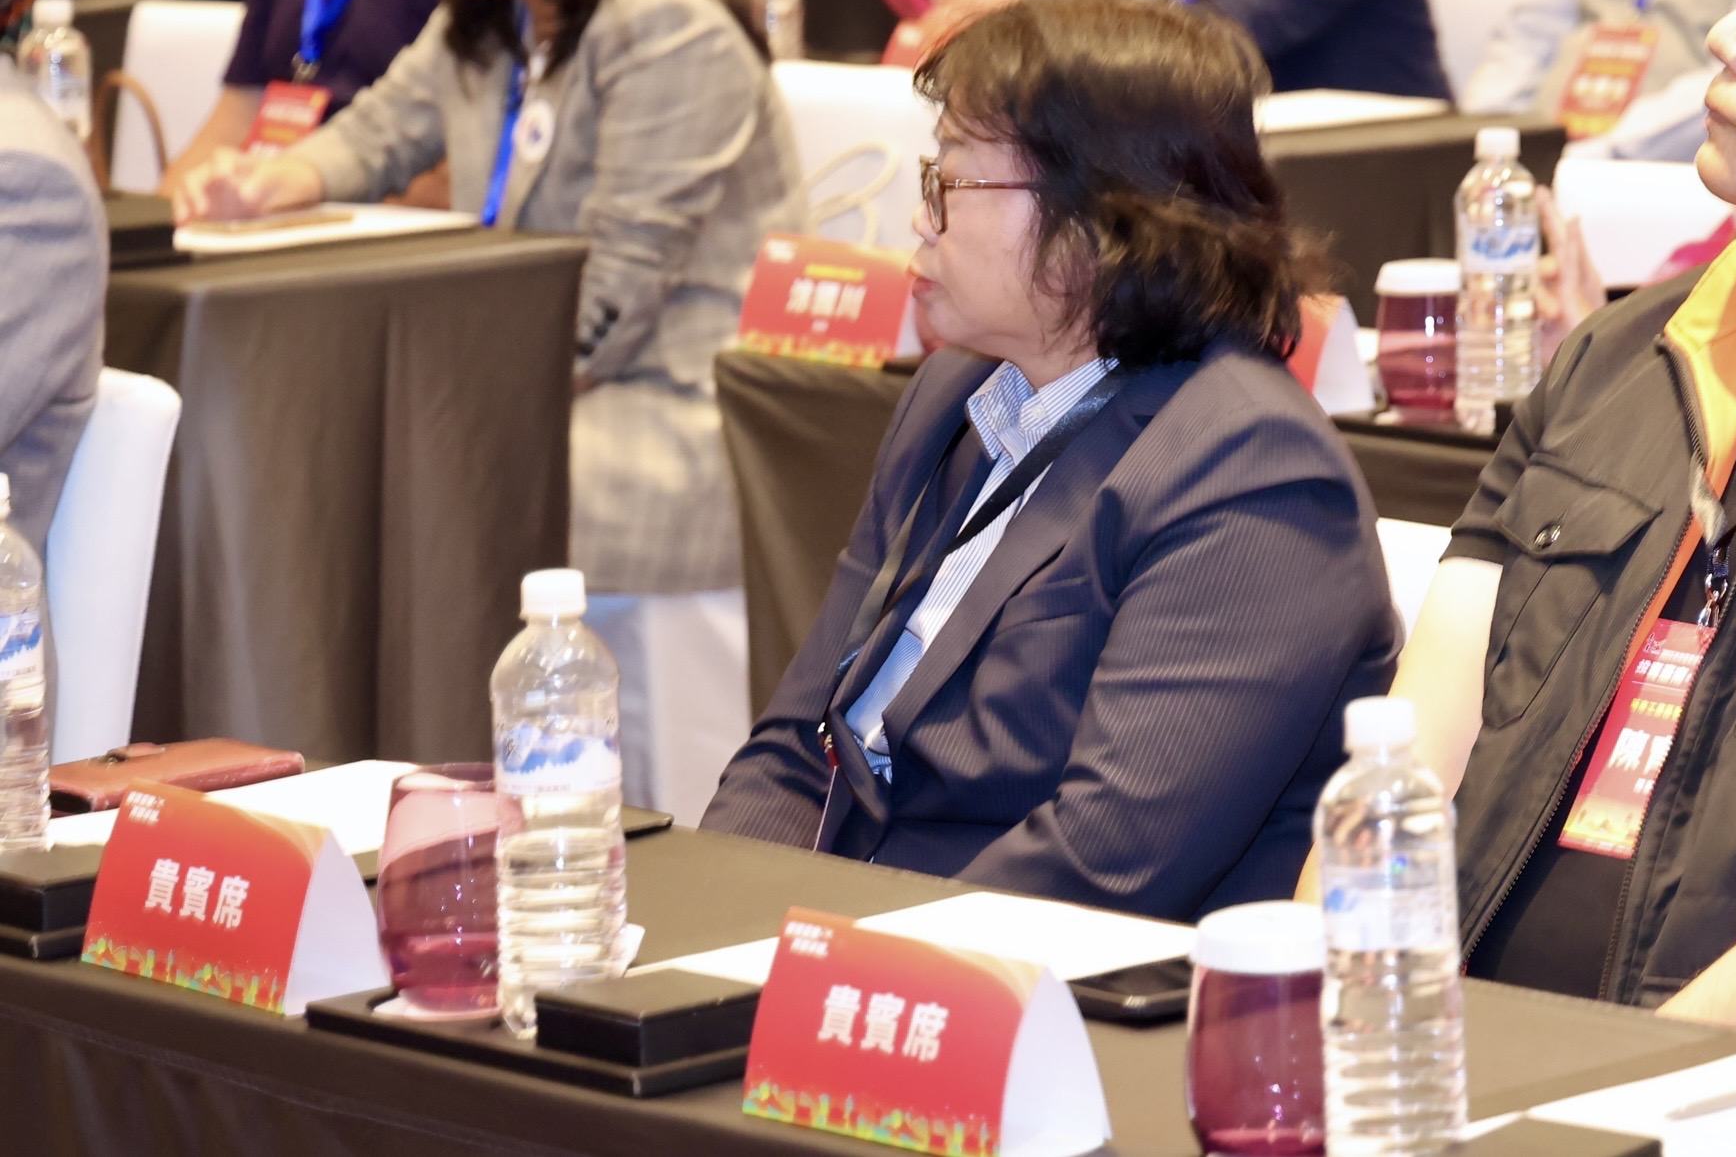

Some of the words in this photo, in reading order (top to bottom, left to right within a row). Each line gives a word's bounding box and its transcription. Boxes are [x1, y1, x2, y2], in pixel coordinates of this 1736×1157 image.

[144, 858, 250, 929] 貴賓席
[817, 984, 949, 1062] 貴賓席
